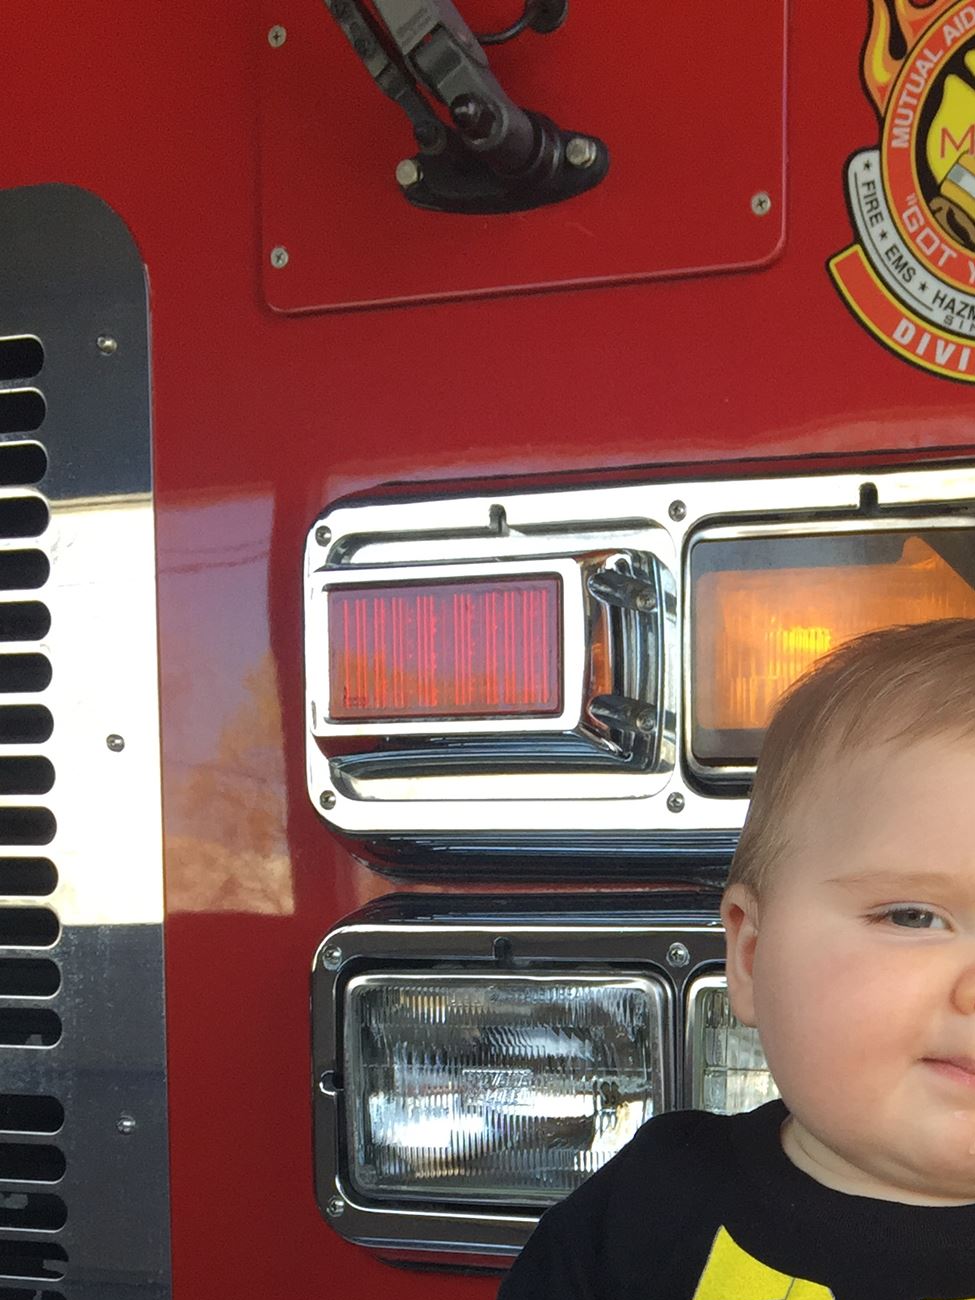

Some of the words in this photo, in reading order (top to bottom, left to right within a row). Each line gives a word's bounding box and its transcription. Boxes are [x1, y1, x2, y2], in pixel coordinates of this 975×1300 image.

[891, 48, 945, 149] MUTUAL
[861, 179, 884, 229] FIRE
[884, 243, 917, 284] EMS
